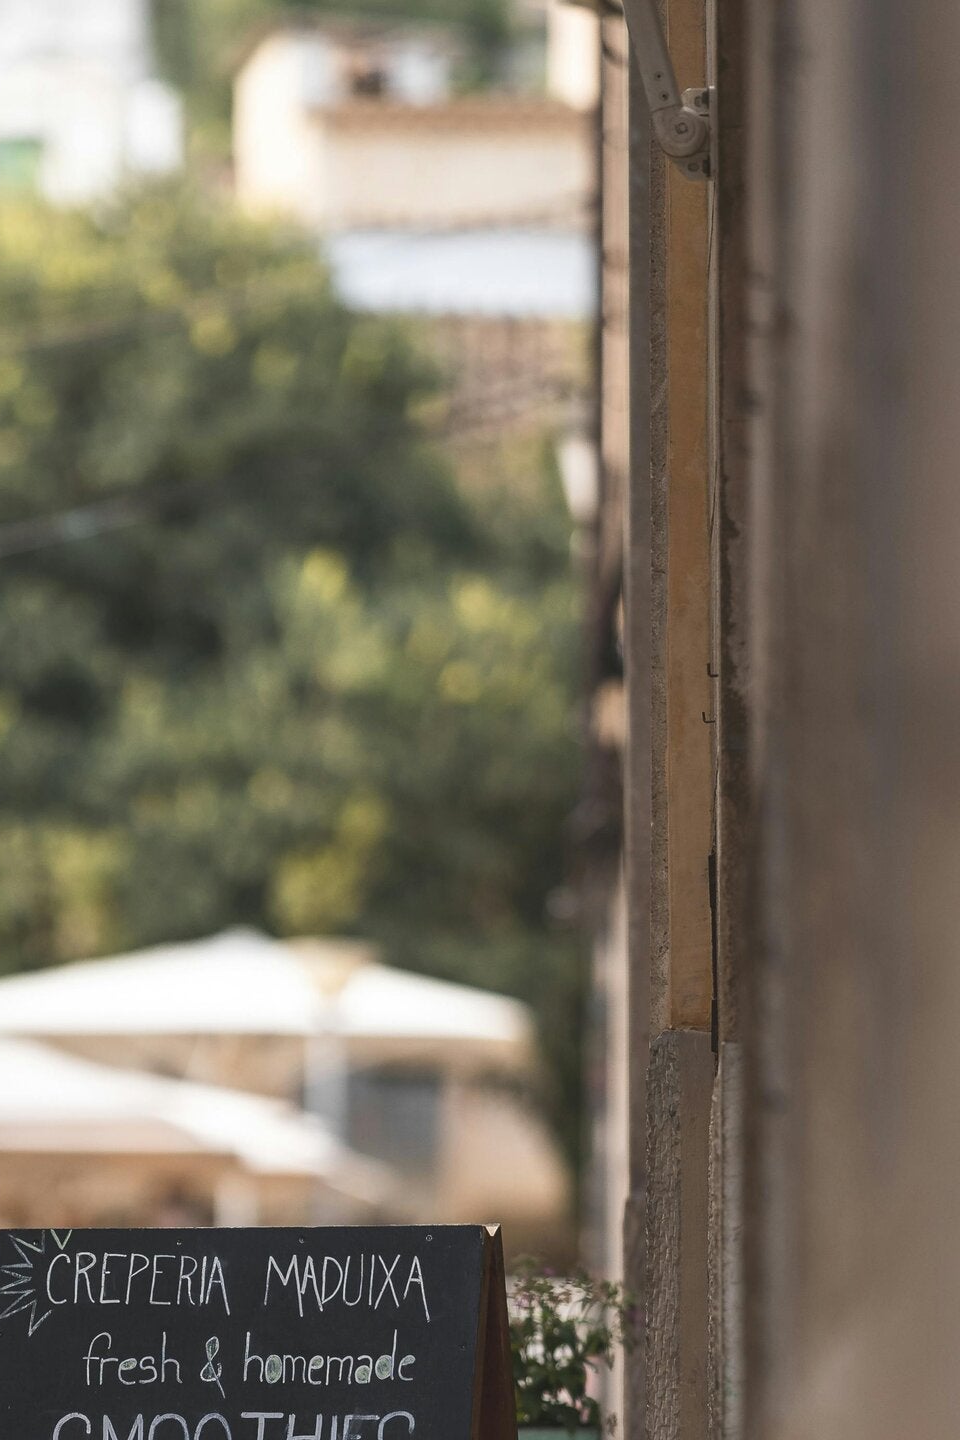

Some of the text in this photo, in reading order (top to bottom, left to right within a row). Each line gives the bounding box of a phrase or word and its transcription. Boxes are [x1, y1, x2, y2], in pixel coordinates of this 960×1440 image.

[46, 1252, 430, 1322] CREPERIA MADUIXA
[82, 1329, 416, 1398] fresh & homemade
